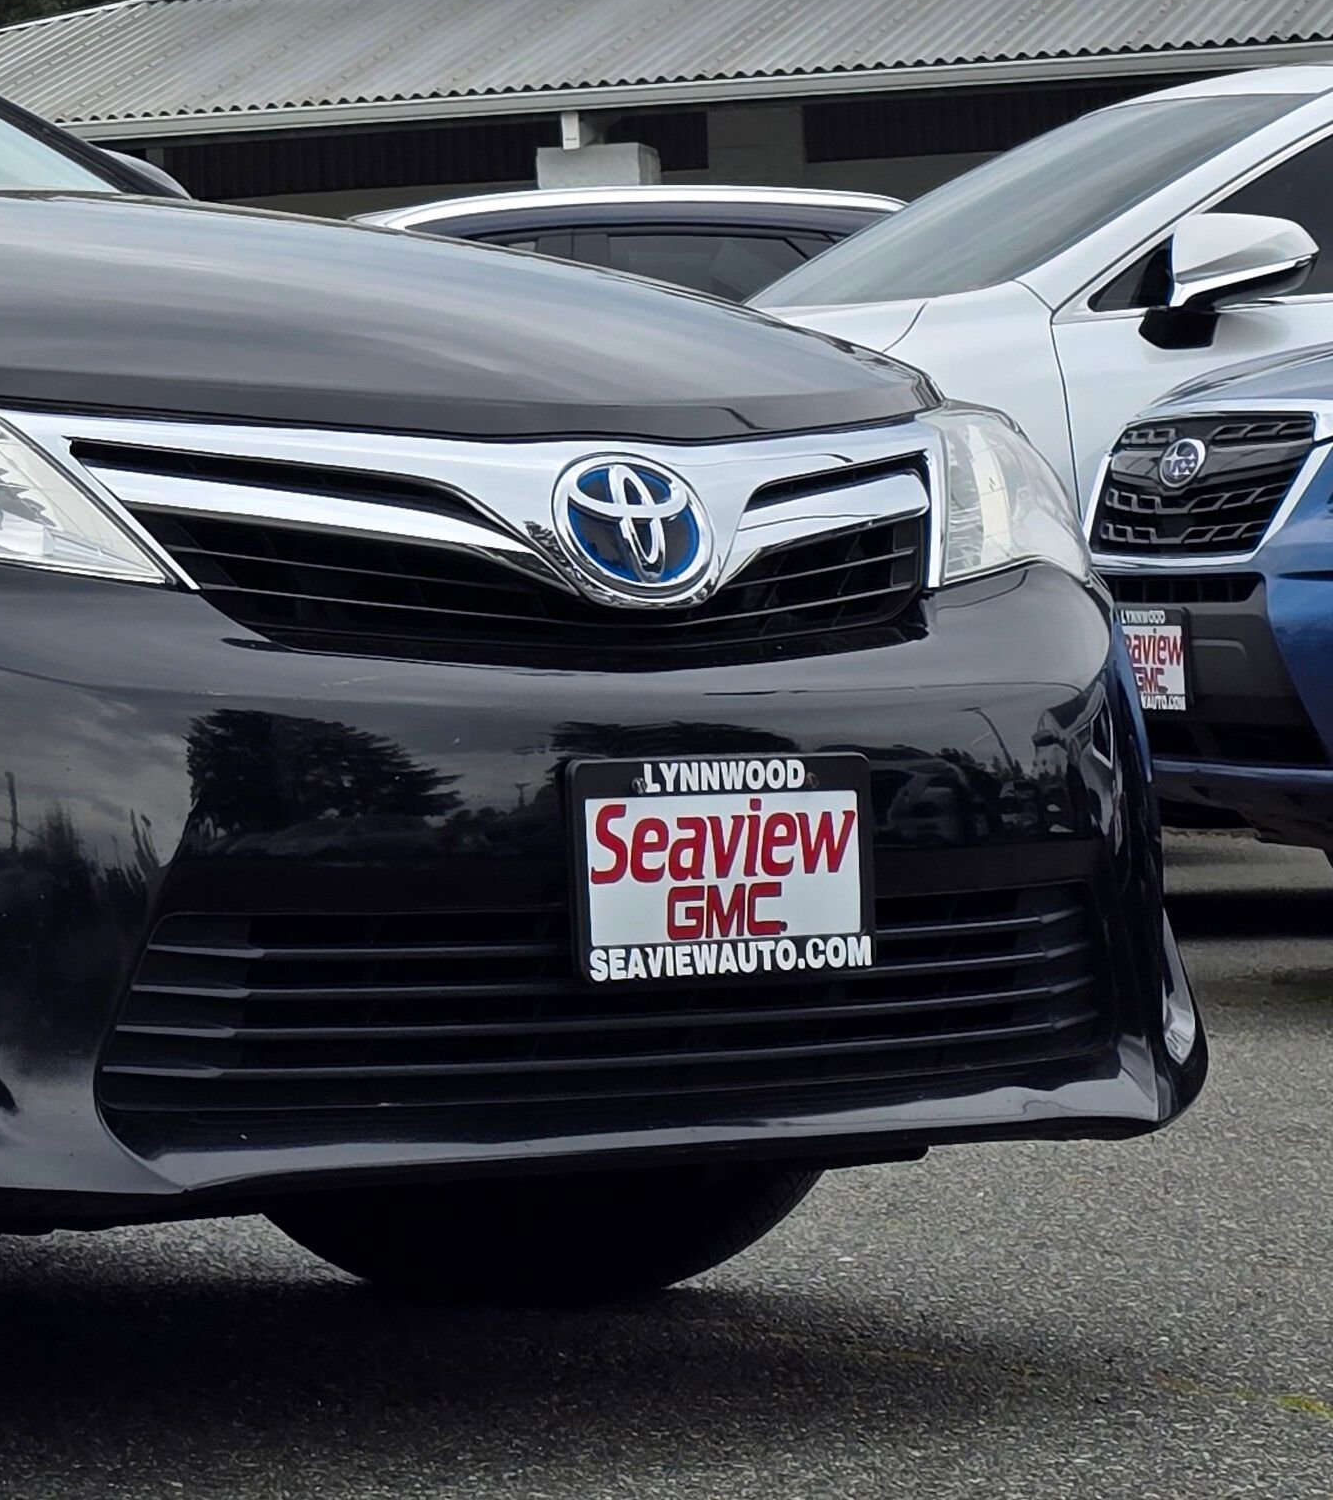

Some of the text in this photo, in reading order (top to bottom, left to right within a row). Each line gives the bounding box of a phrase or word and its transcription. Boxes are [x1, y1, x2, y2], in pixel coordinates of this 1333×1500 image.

[644, 760, 806, 793] LYNNWOOD
[591, 798, 856, 884] Seaview
[667, 882, 784, 940] GMC
[590, 936, 872, 982] SEAVIEWAUTO.COM
